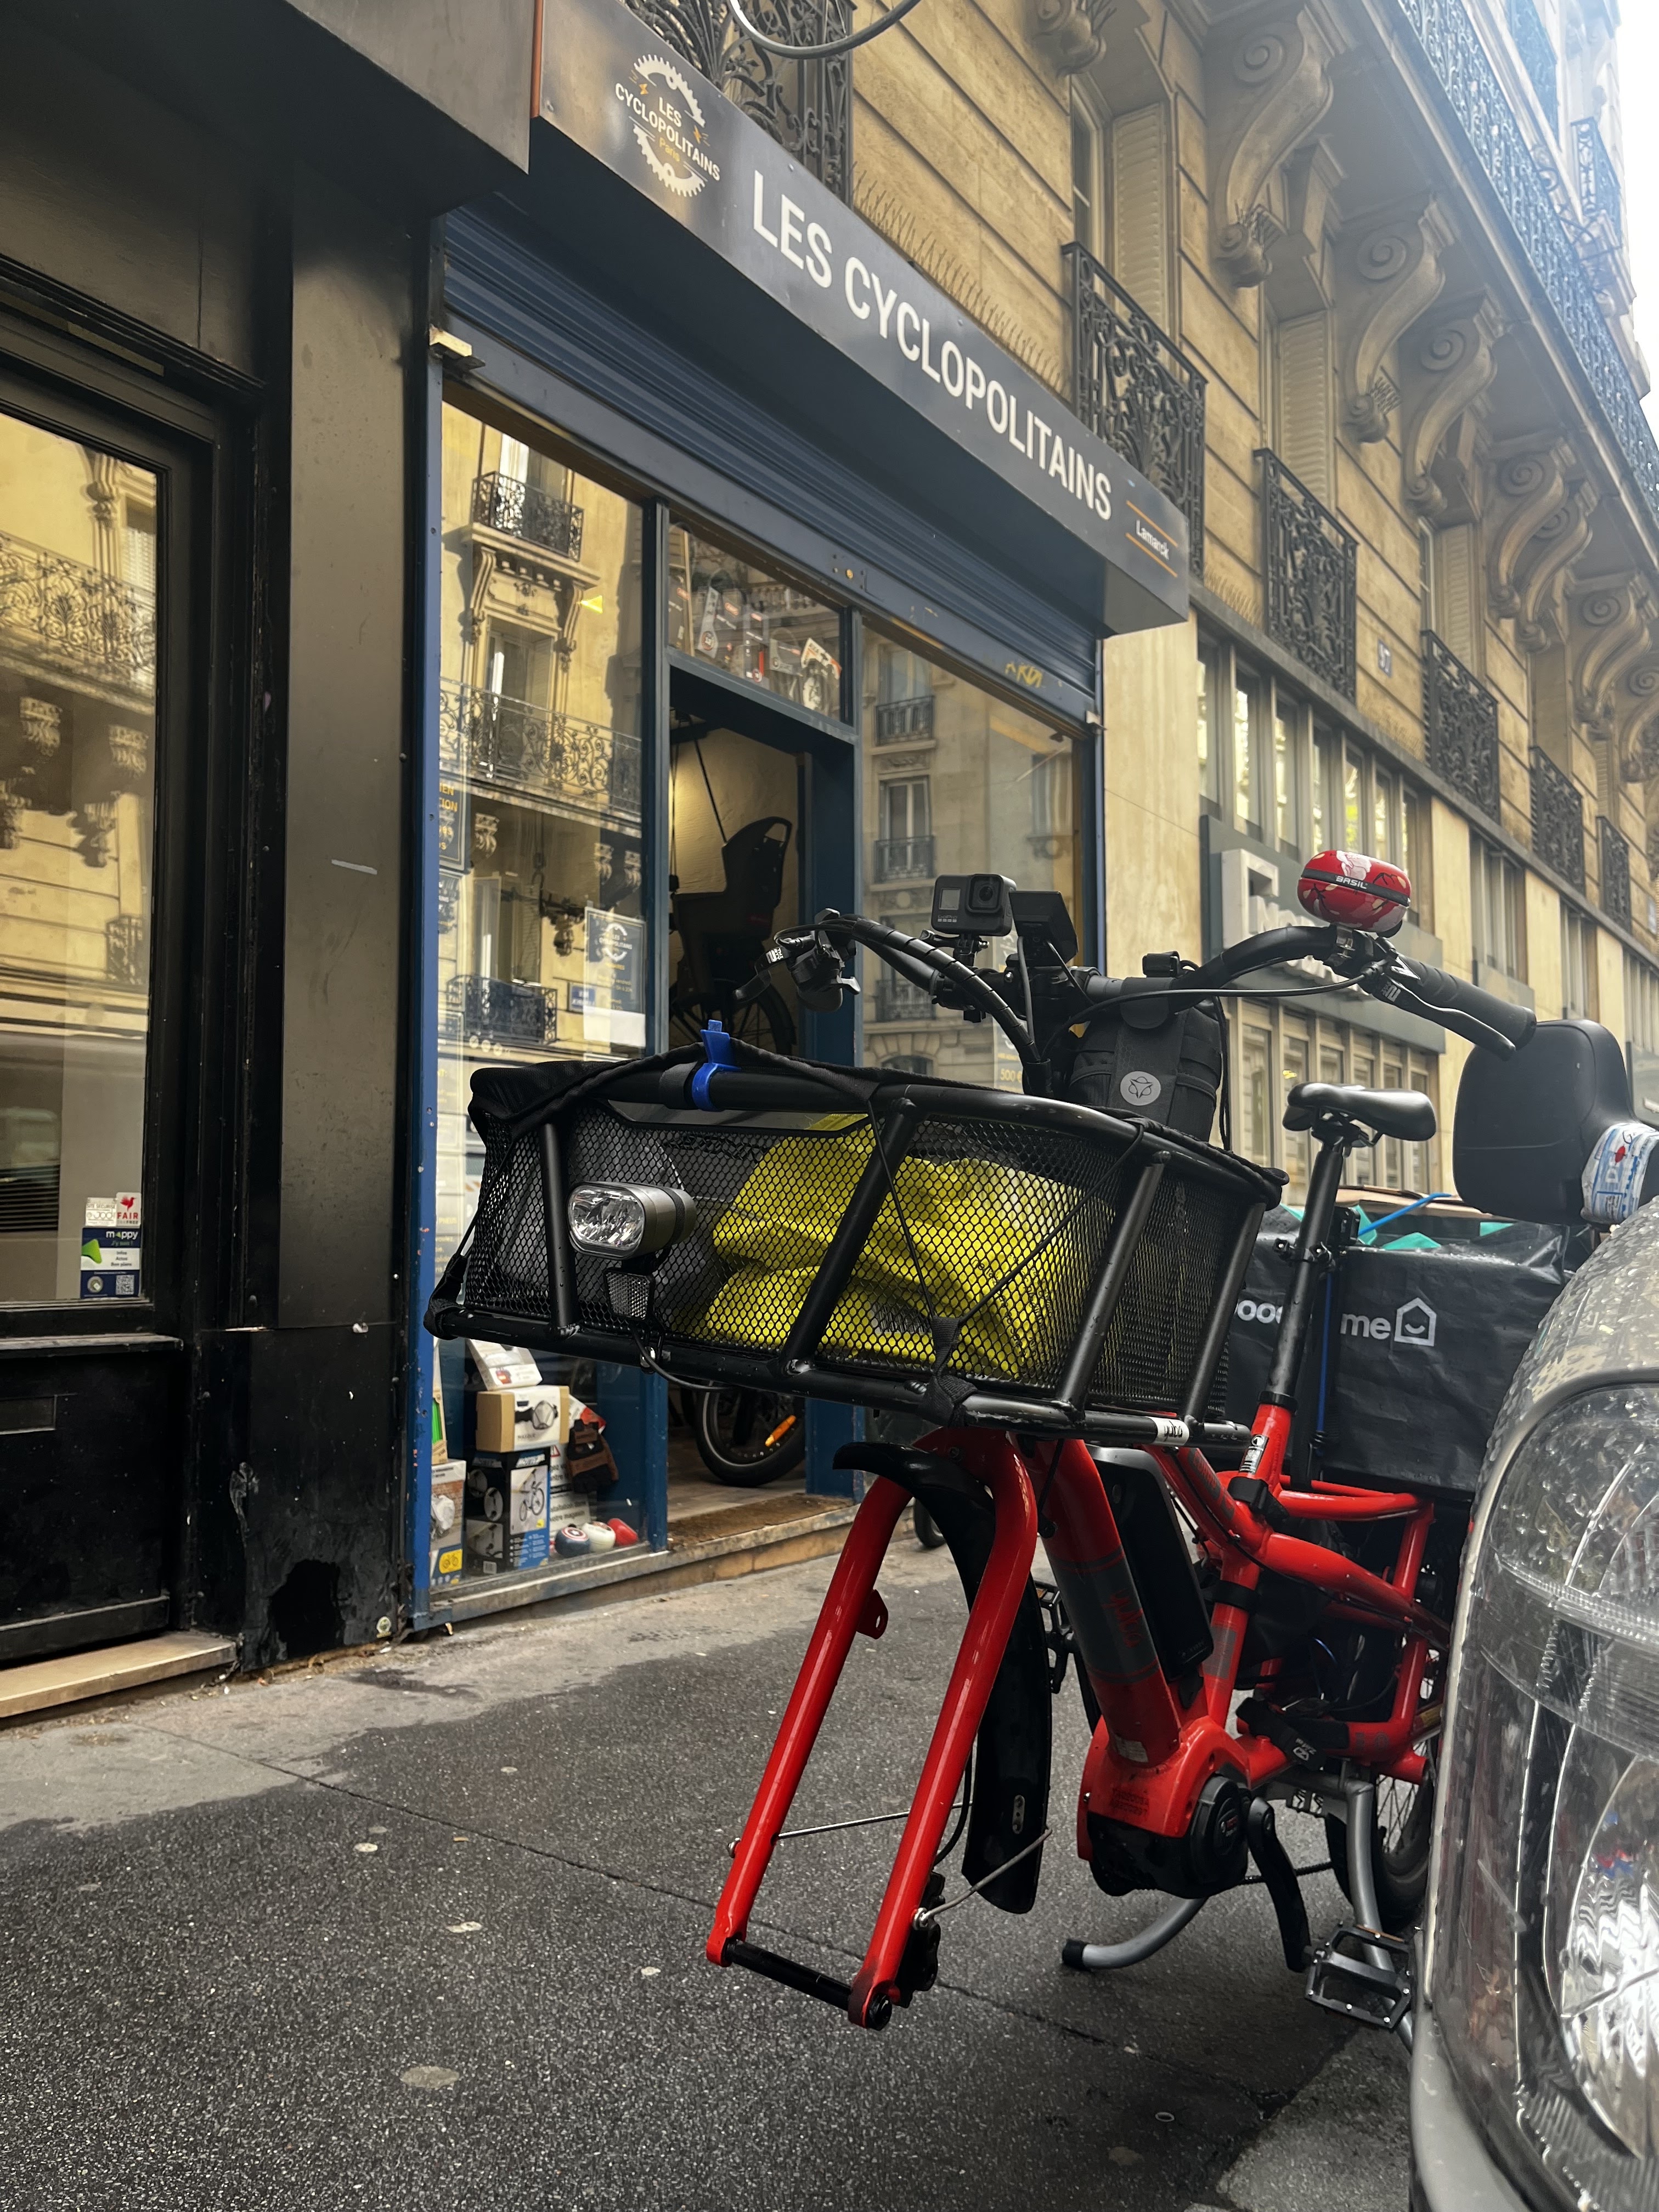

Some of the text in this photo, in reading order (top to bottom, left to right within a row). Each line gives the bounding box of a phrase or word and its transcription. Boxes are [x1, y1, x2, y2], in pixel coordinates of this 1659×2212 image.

[659, 97, 682, 127] LES
[615, 83, 720, 181] CYCLOPOLITAINS
[659, 137, 680, 162] Paris
[753, 170, 1113, 520] LES CYCLOPOLITAINS
[1335, 876, 1367, 889] BASIL
